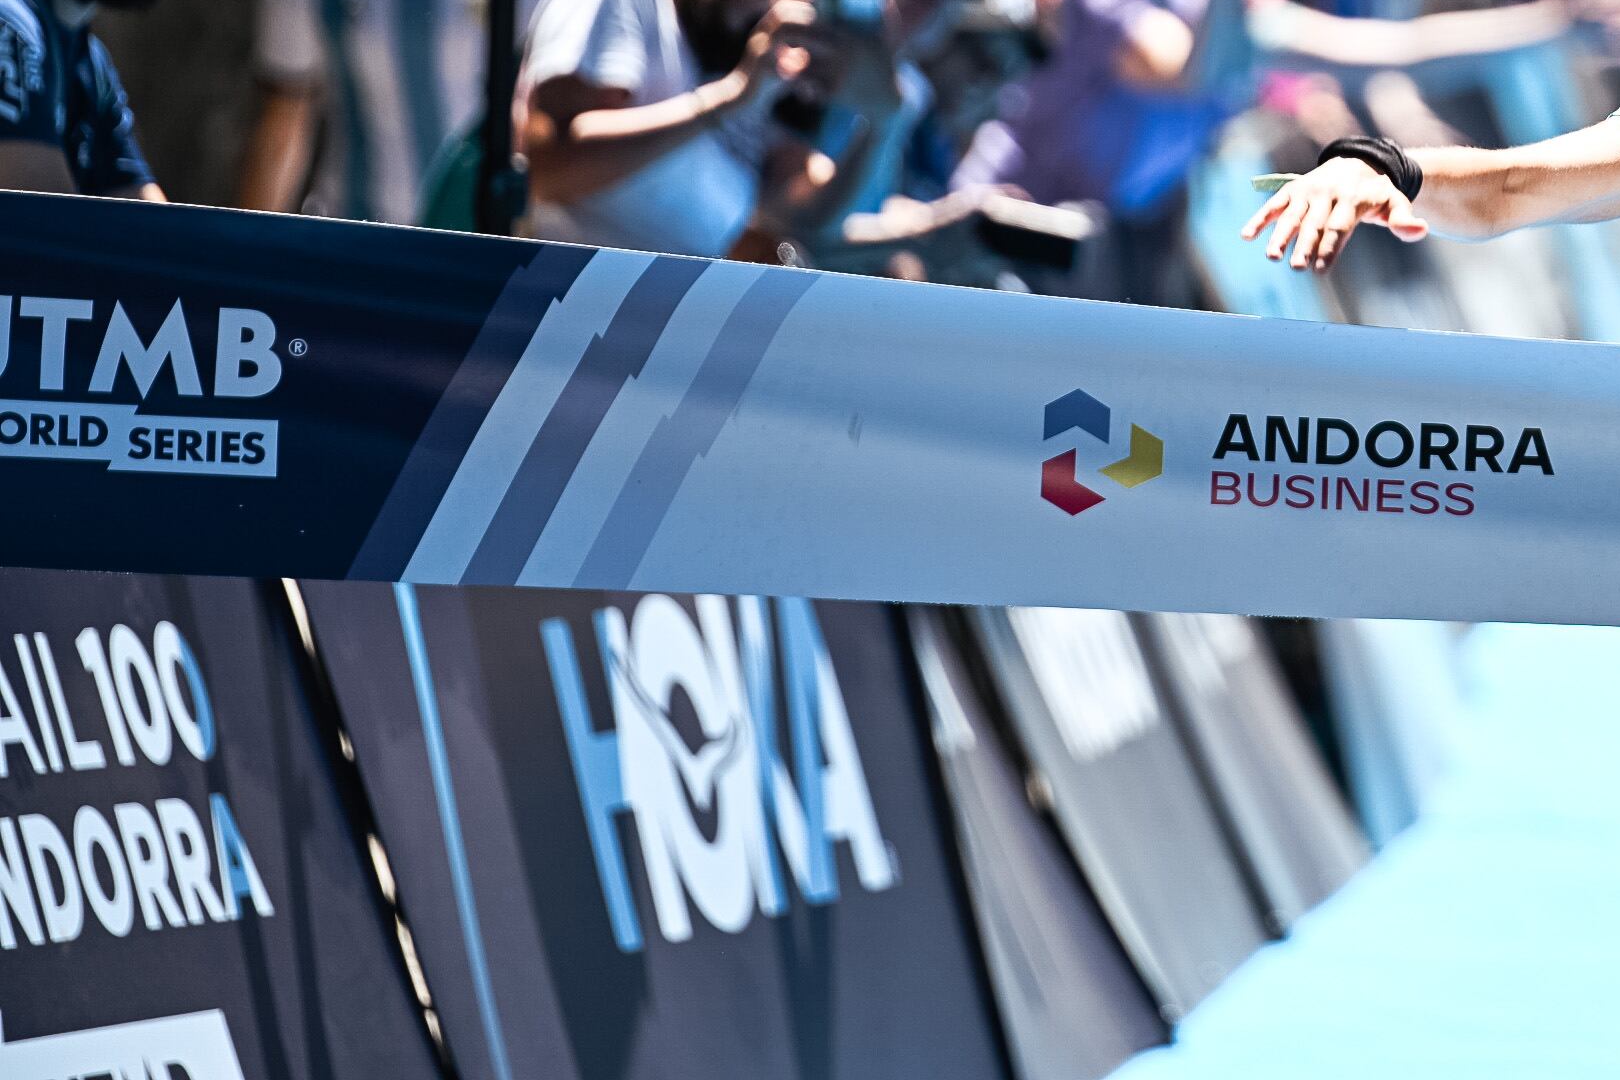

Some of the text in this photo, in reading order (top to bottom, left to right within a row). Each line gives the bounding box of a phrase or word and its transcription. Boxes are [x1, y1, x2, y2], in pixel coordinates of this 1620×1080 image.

[0, 411, 266, 465] ORLD SERIES
[1212, 413, 1555, 476] ANDORRA
[1210, 470, 1476, 517] BUSINESS
[0, 620, 216, 778] AIL 100
[540, 592, 896, 954] HOKA
[0, 792, 275, 950] NDORRA
